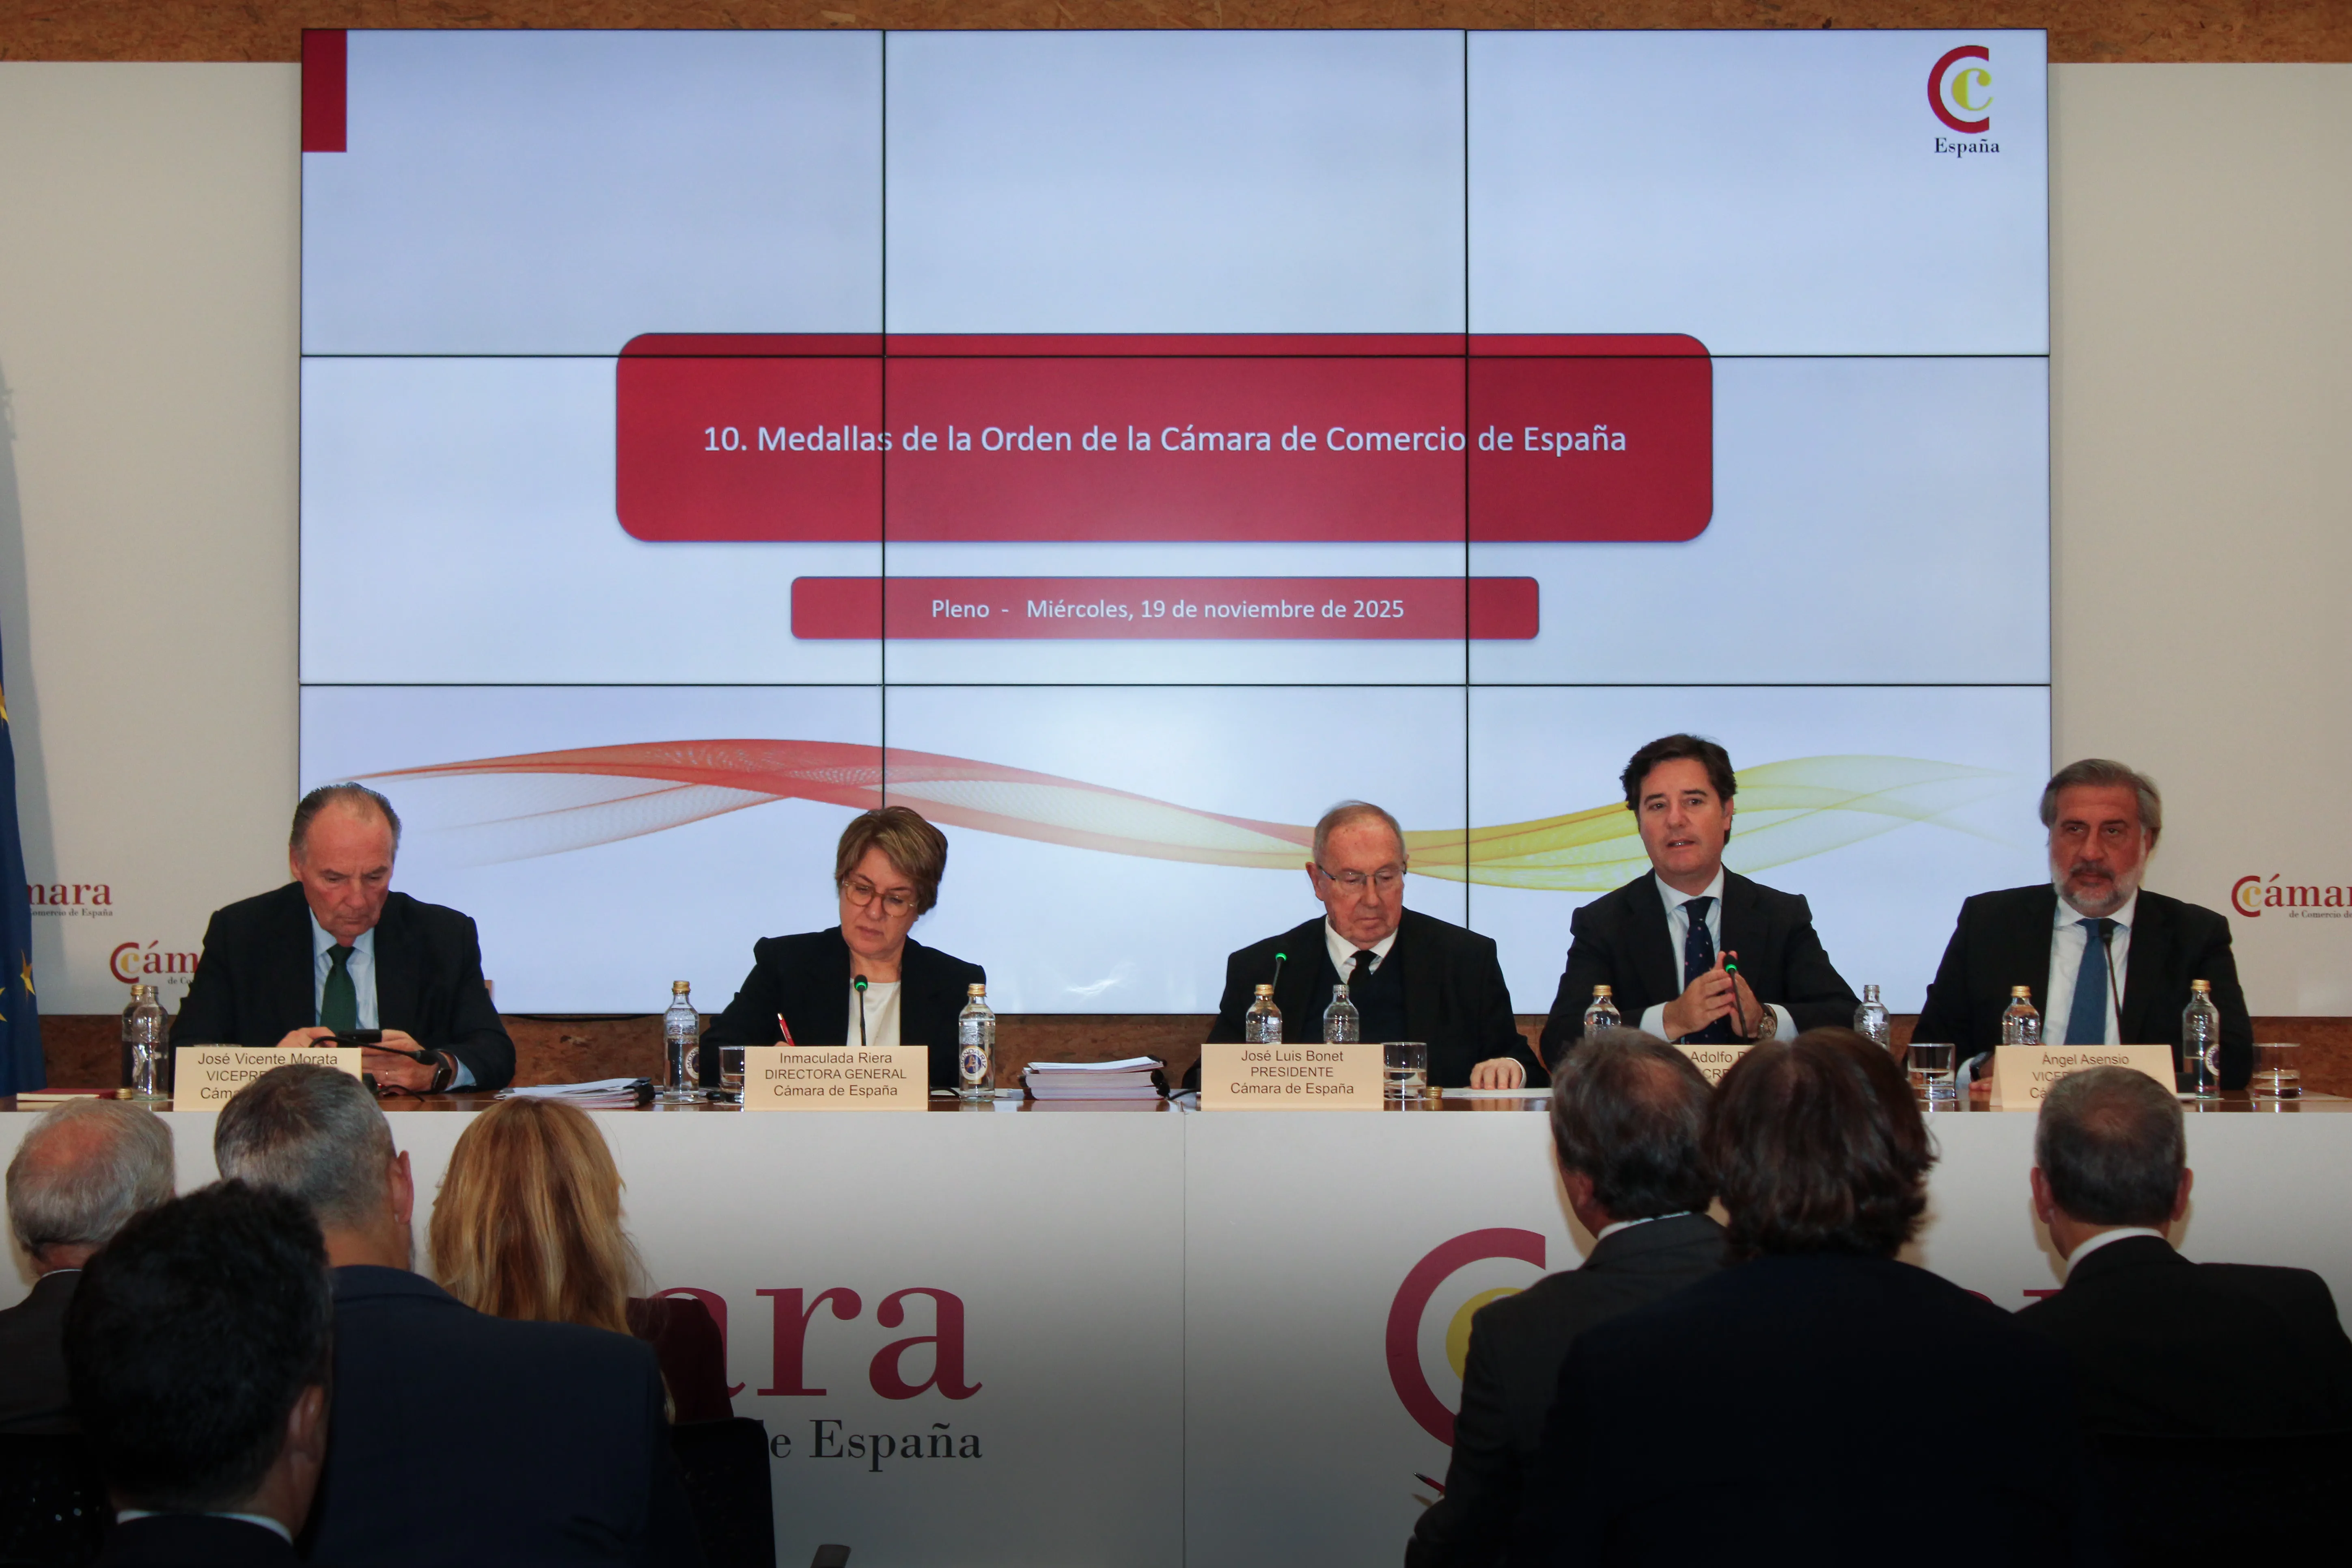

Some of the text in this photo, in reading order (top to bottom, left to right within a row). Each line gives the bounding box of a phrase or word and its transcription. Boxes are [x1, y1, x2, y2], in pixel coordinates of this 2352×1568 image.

[1934, 137, 2000, 158] España
[705, 424, 1625, 457] 10. Medallas de la Orden de la Cámara de Comercio de España
[933, 600, 989, 617] Pleno
[1028, 599, 1134, 621] Miércoles,
[1141, 600, 1165, 618] 19
[1172, 599, 1197, 618] de
[1205, 600, 1315, 618] noviembre
[1322, 600, 1346, 618] de
[1354, 600, 1403, 618] 2025
[31, 908, 113, 919] omercio de España
[2289, 910, 2299, 918] de
[2301, 910, 2341, 918] Comercio
[167, 976, 177, 985] de
[198, 1053, 338, 1065] José Vicente Morata
[780, 1052, 892, 1063] Inmaculada Riera
[961, 1048, 987, 1070] MONDARIZ
[1241, 1050, 1343, 1061] José Luis Bonet
[1691, 1051, 1733, 1063] Adolfo
[2042, 1052, 2130, 1068] Ángel Asensio
[765, 1069, 907, 1079] DIRECTORA GENERAL
[1251, 1067, 1334, 1077] PRESIDENTE
[774, 1085, 897, 1098] Cámara de España
[1231, 1083, 1354, 1097] Cámara de España
[809, 1419, 983, 1473] España
